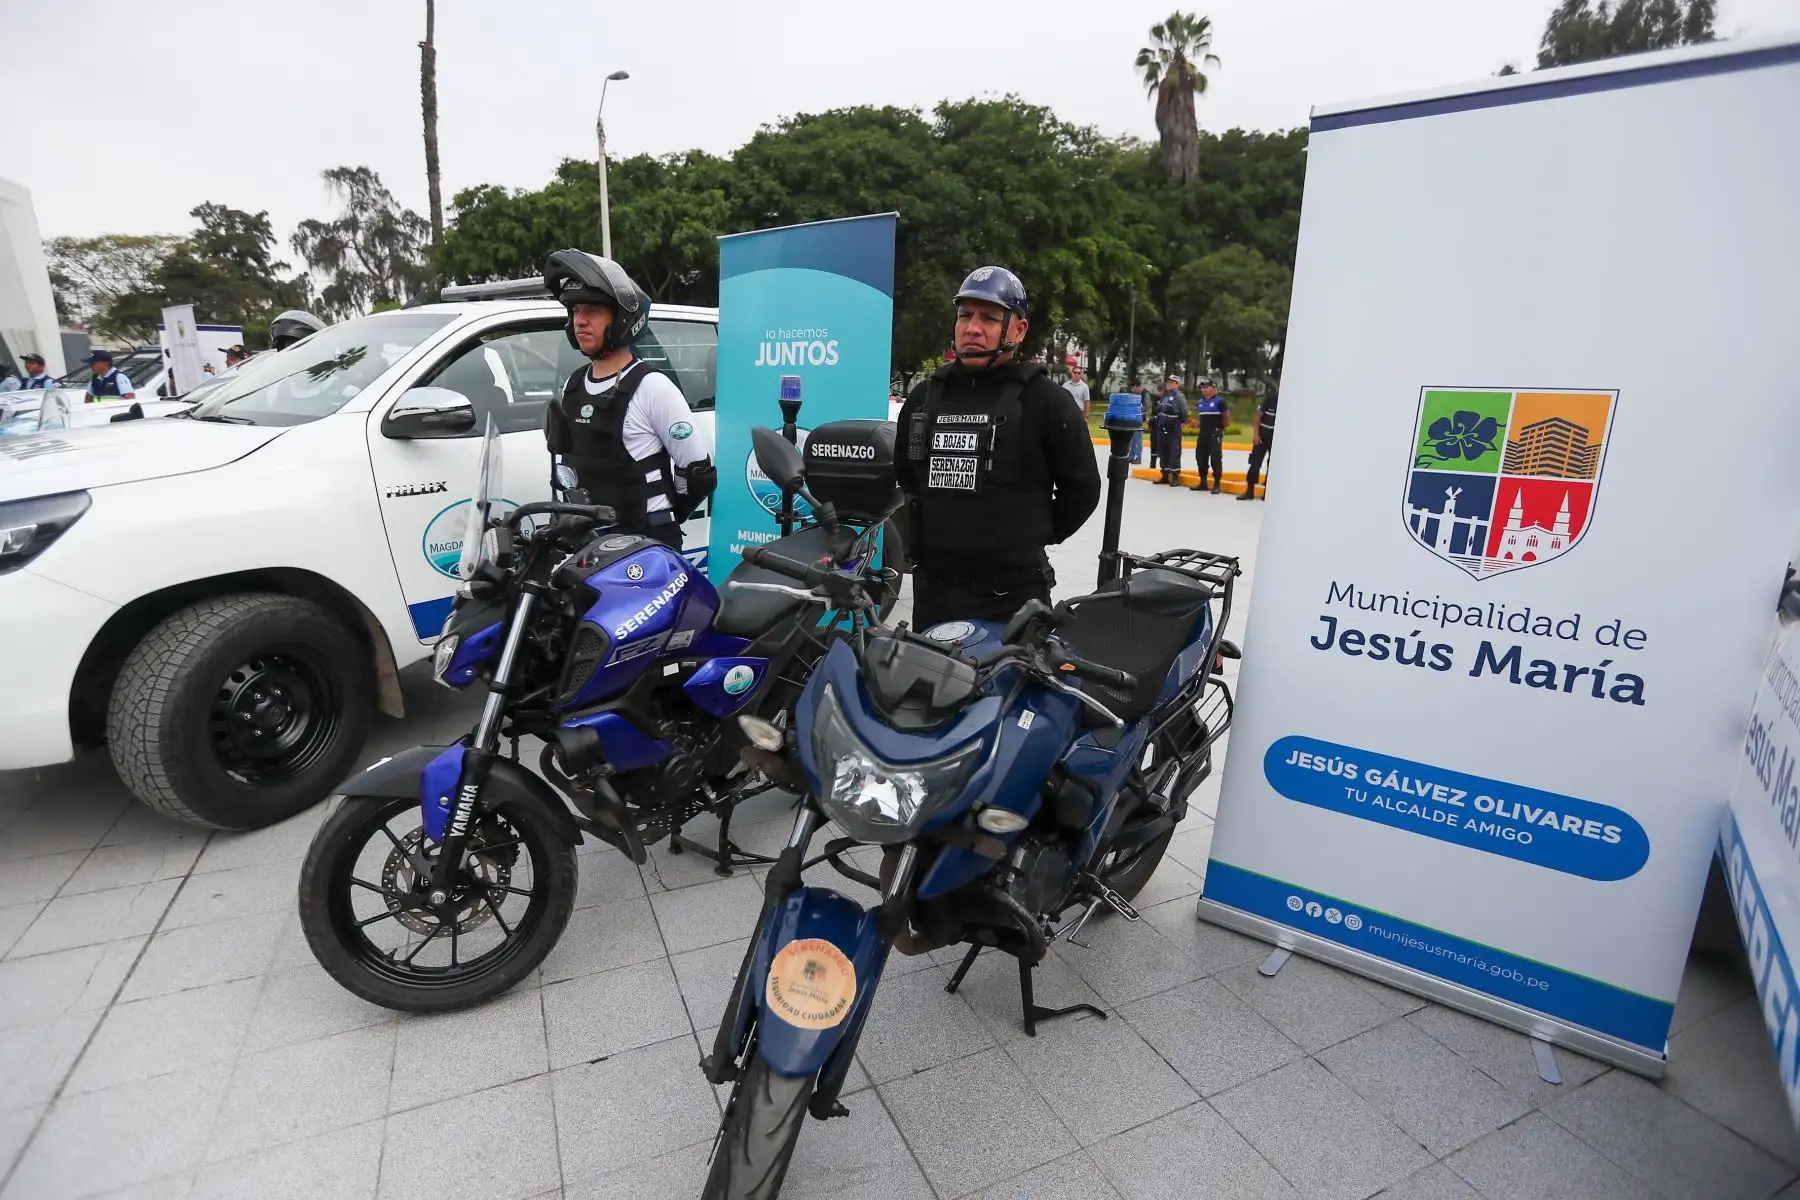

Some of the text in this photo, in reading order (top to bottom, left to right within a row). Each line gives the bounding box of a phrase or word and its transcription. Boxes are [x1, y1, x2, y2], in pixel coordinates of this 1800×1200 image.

[754, 340, 839, 366] JUNTOS
[766, 327, 828, 339] lo hacemos
[811, 443, 875, 460] SERENAZGO
[943, 434, 967, 449] ROJAS
[930, 472, 975, 489] MOTORIZADO
[931, 458, 976, 473] SERENAZGO
[614, 572, 689, 640] SERENAZGO
[1325, 581, 1648, 650] Municipalidad de
[1310, 615, 1646, 706] Jesús María
[450, 785, 479, 836] YAMAHA
[1285, 750, 1623, 845] JESÚS GÁLVEZ OLIVARES
[1344, 787, 1533, 845] TU ALCALDE AMIGO
[1368, 923, 1549, 991] munijesusmaria.gob.pe
[771, 976, 847, 1020] SEGURIDAD CIUDADANA
